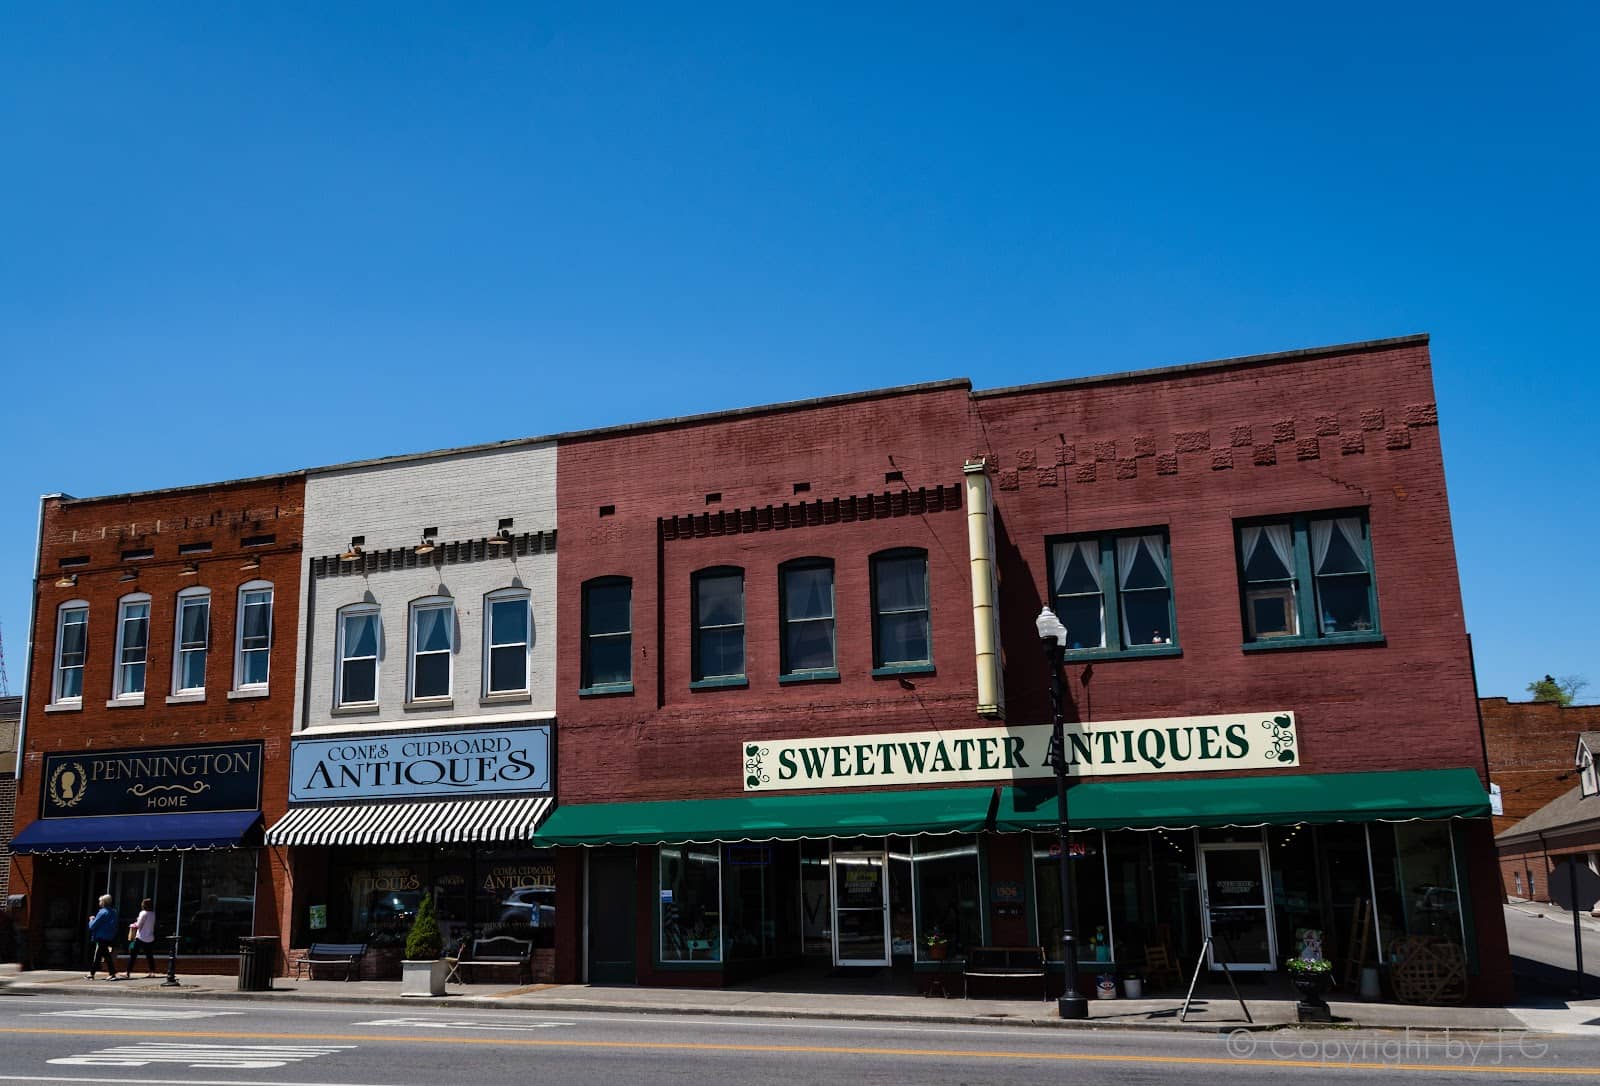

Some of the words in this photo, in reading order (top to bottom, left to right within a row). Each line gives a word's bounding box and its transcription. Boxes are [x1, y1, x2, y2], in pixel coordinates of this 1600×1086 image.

[328, 743, 389, 761] CONES
[402, 737, 512, 758] CUPBOARD
[778, 735, 1030, 780] SWEETWATER
[91, 751, 252, 781] PENNINGTON
[303, 748, 535, 789] ANTIQUES
[147, 795, 188, 808] HOME
